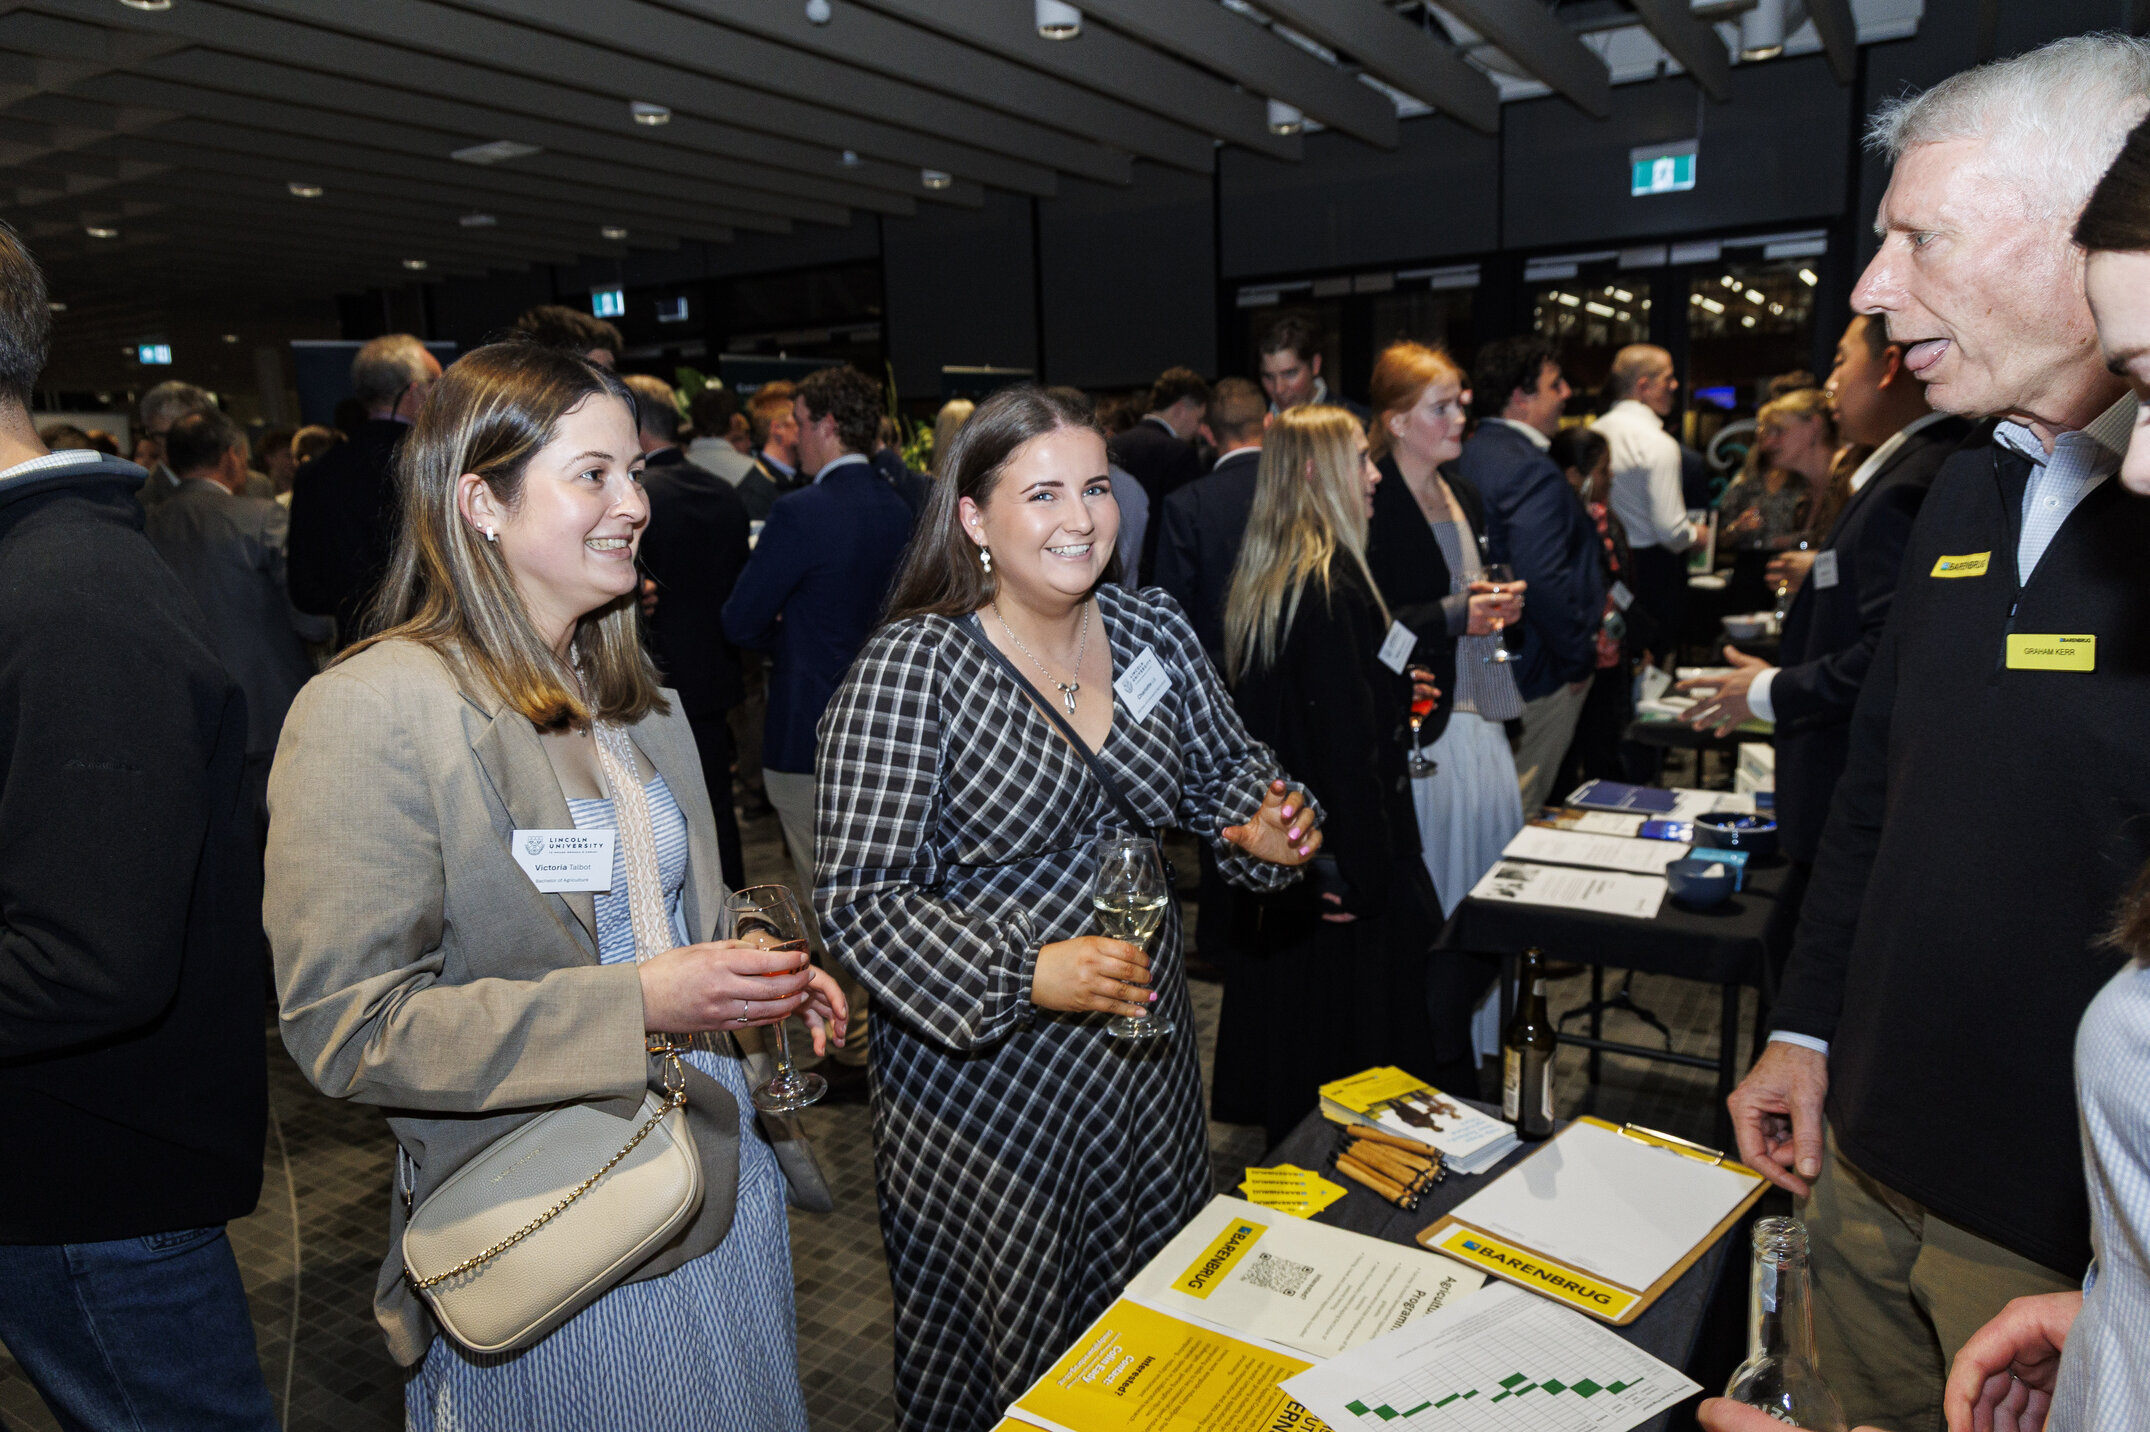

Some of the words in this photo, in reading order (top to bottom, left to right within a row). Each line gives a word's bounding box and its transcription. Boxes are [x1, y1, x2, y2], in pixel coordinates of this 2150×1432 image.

[2023, 647, 2054, 656] GRAHAM
[2055, 648, 2076, 656] KERR
[535, 864, 567, 872] Victoria
[1188, 1232, 1247, 1290] BARENBRUG
[1477, 1246, 1612, 1305] BARENBRUG
[1387, 1289, 1427, 1333] Programm
[1422, 1275, 1457, 1318] Agricultu
[1100, 1346, 1122, 1365] Colin
[1103, 1355, 1135, 1386] Contact:
[1082, 1363, 1106, 1383] Eady
[1115, 1355, 1156, 1396] Interested?
[1267, 1400, 1306, 1432] ERN
